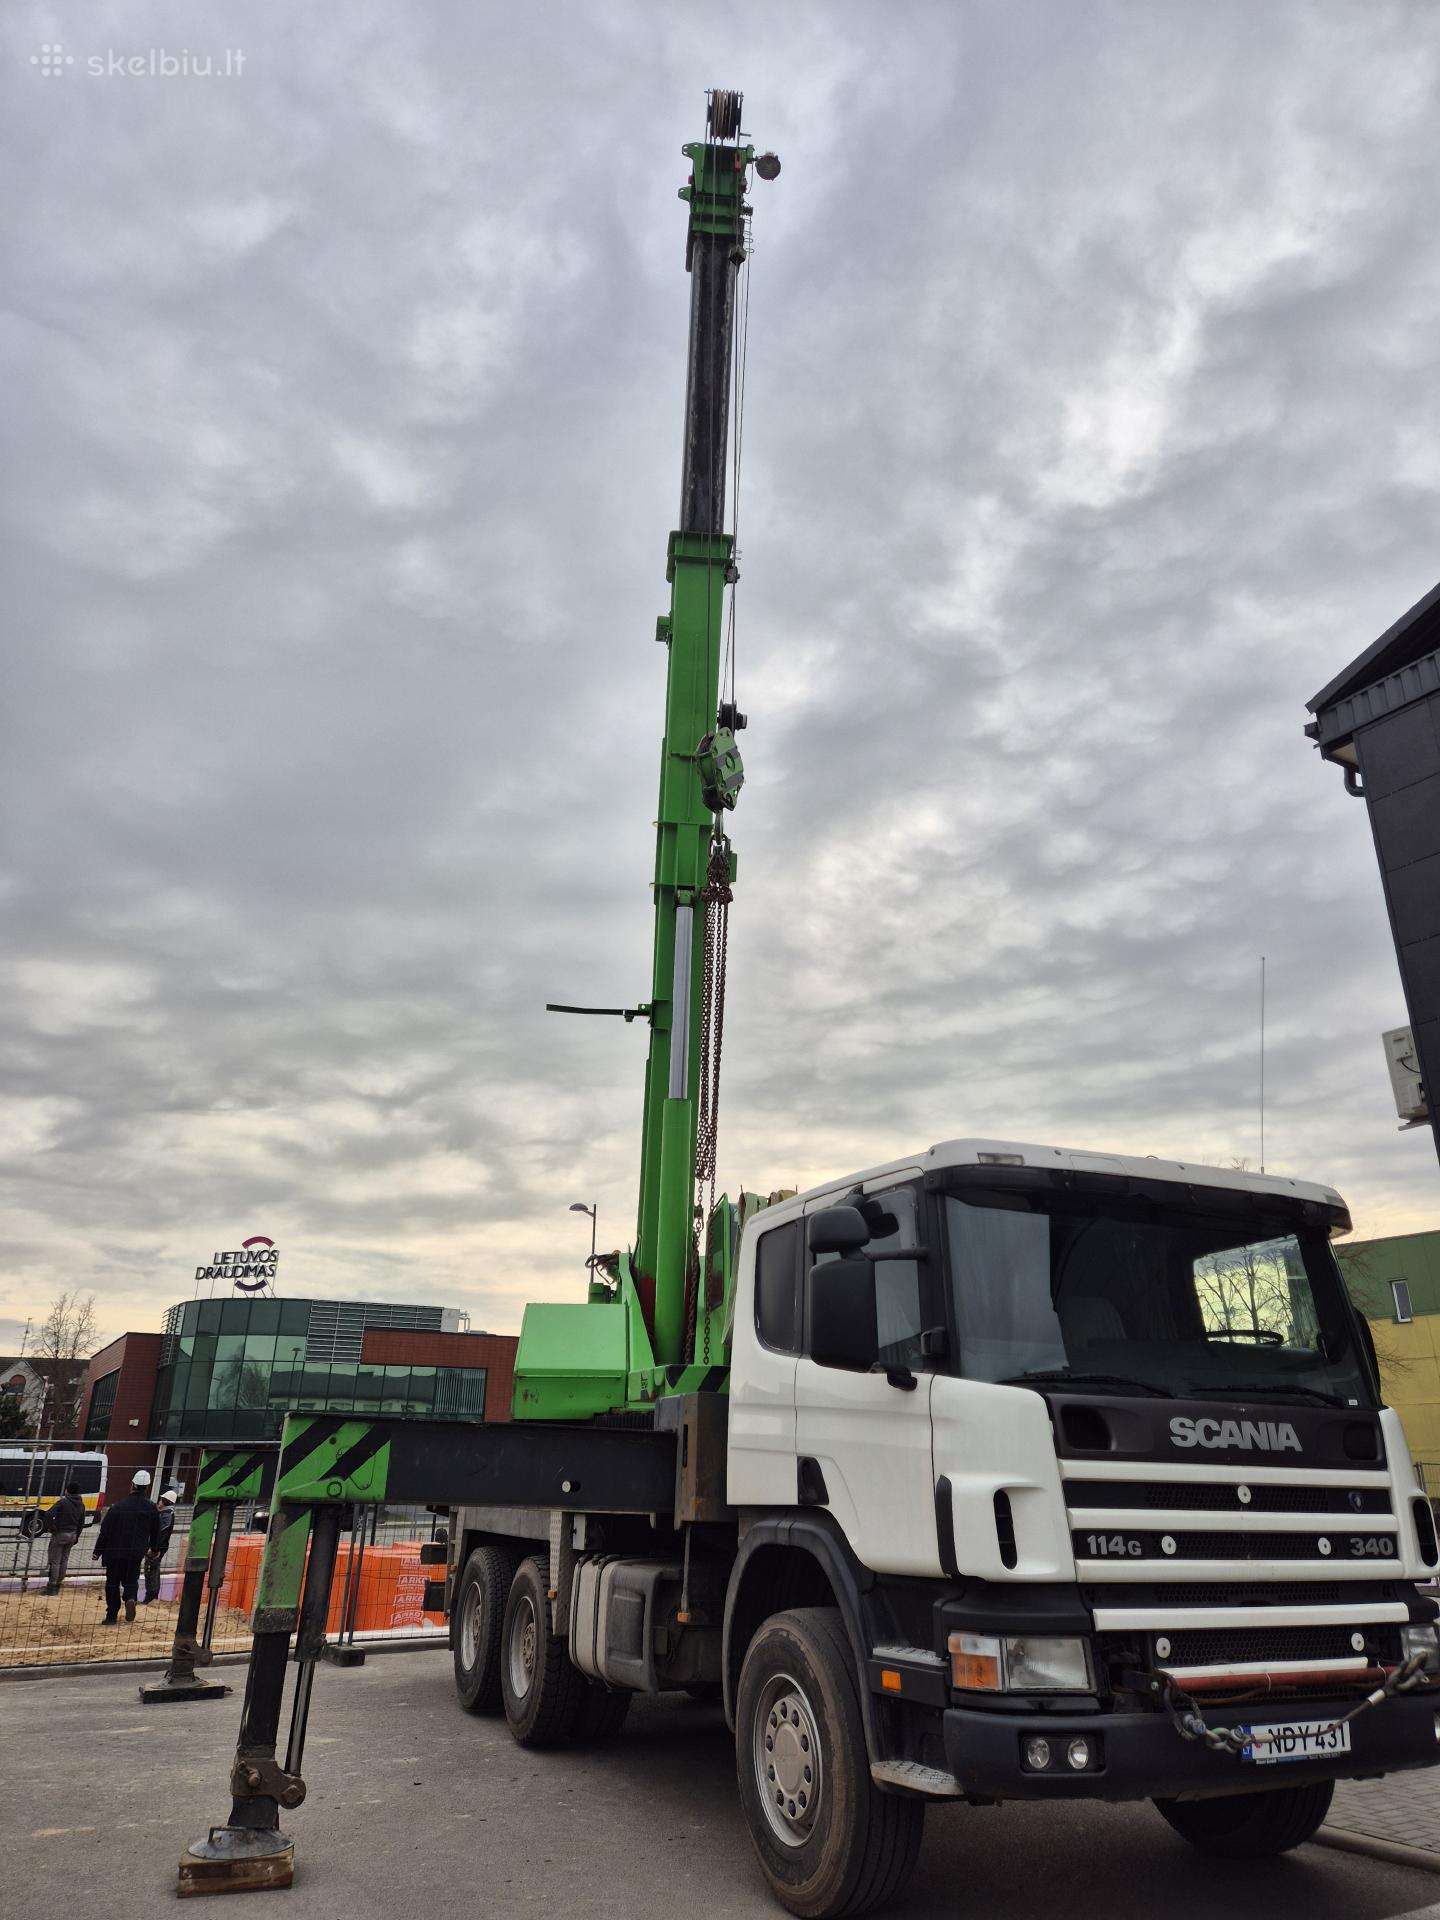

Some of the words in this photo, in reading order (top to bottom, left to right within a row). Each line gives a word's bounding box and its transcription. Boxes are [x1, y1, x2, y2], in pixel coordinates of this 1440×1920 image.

[195, 1264, 276, 1280] DRAUDIMAS
[1169, 1416, 1303, 1452] SCANIA
[1350, 1537, 1393, 1556] 340
